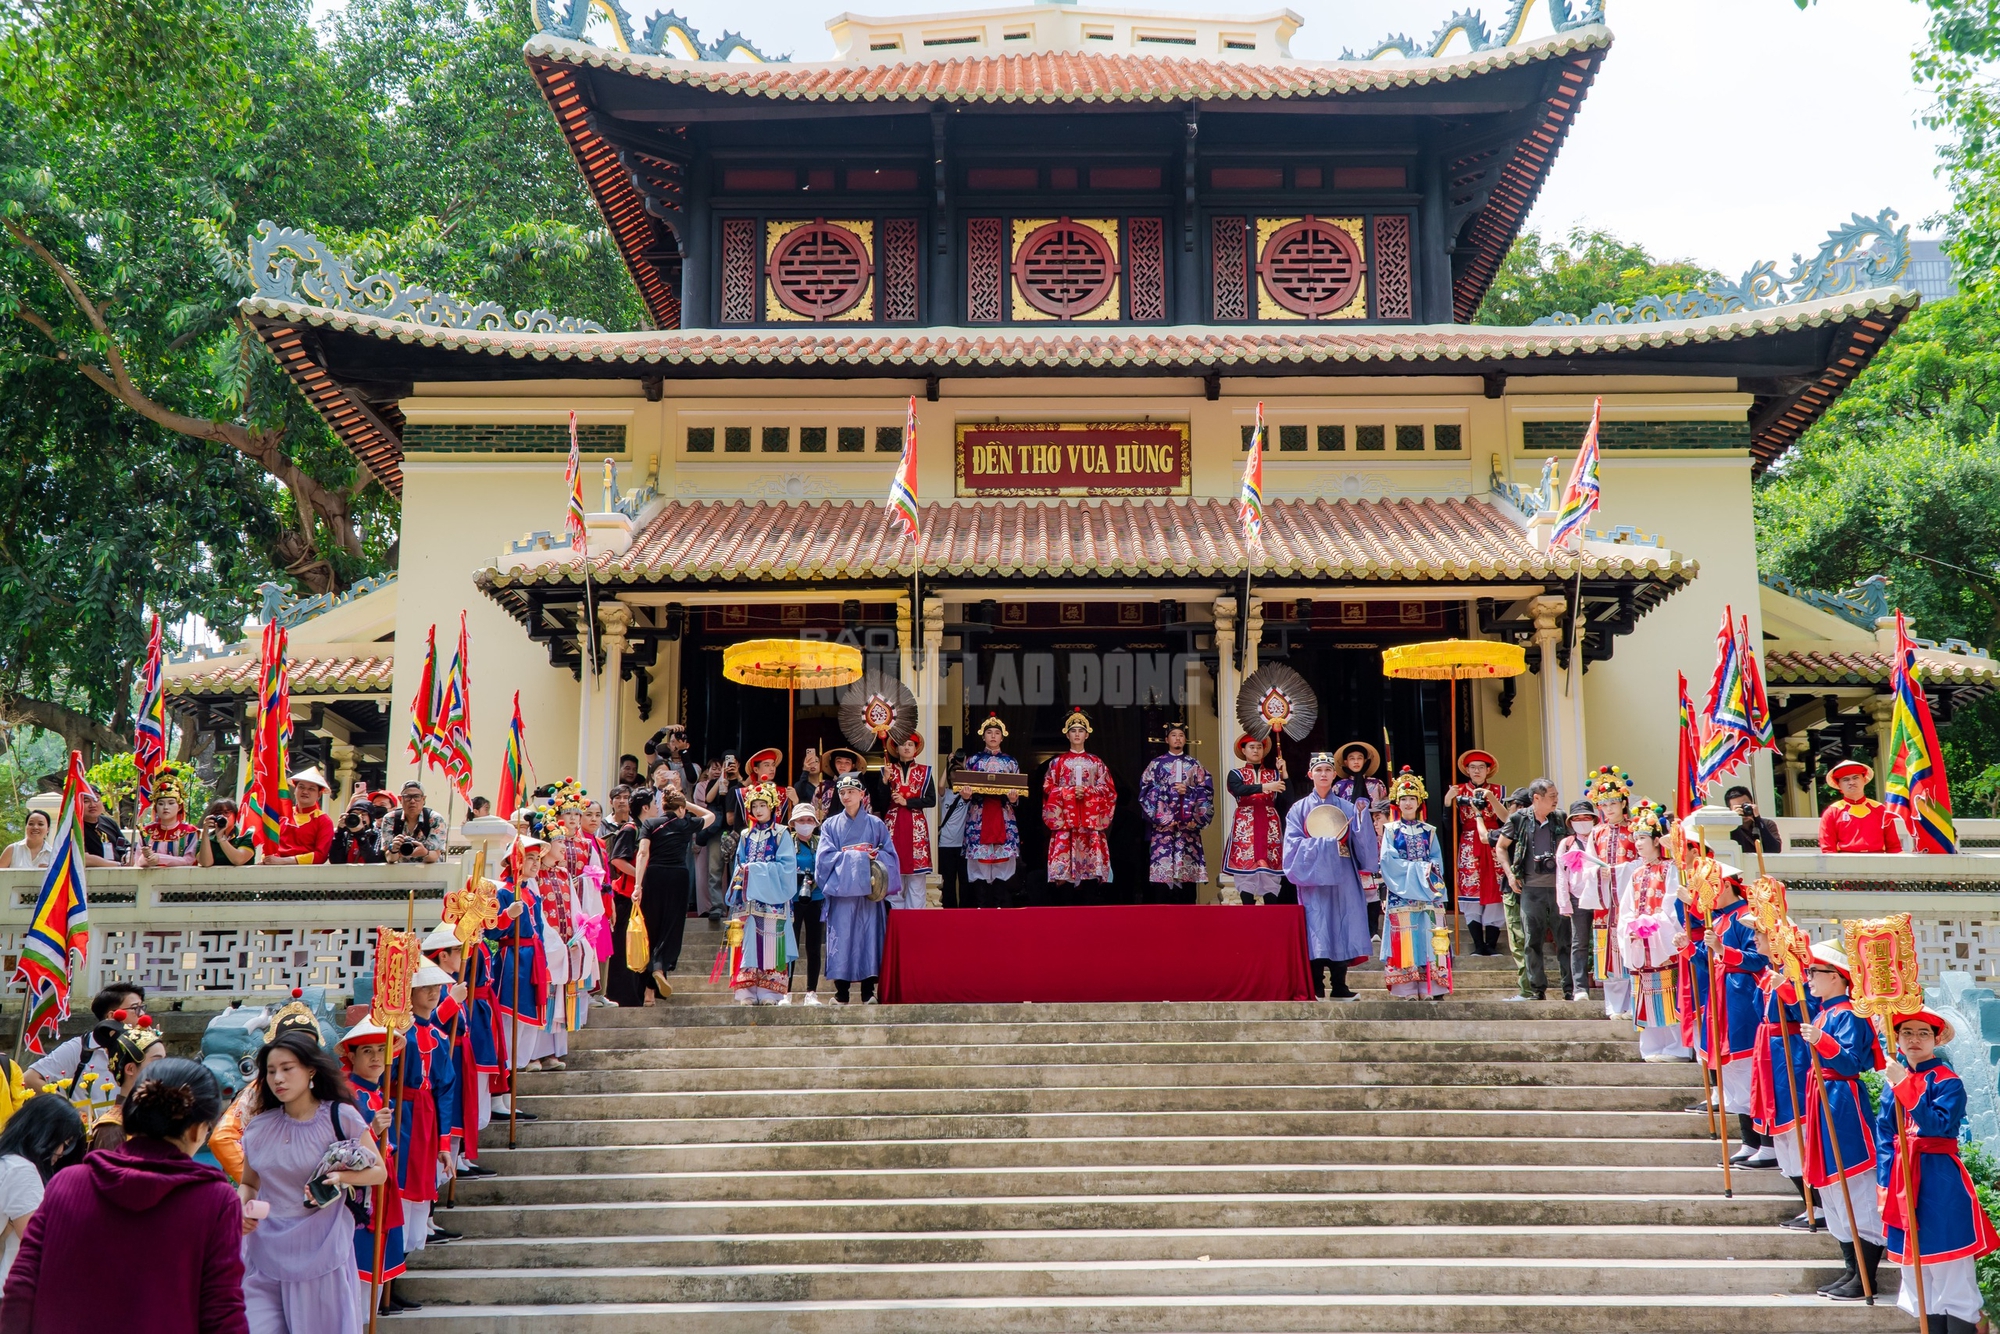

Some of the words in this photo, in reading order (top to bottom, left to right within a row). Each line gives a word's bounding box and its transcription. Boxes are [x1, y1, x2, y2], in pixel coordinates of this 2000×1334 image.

[970, 441, 1014, 474] ĐỀN
[1018, 441, 1062, 474] THỜ
[1067, 444, 1111, 474] VUA
[1115, 440, 1174, 474] HÙNG
